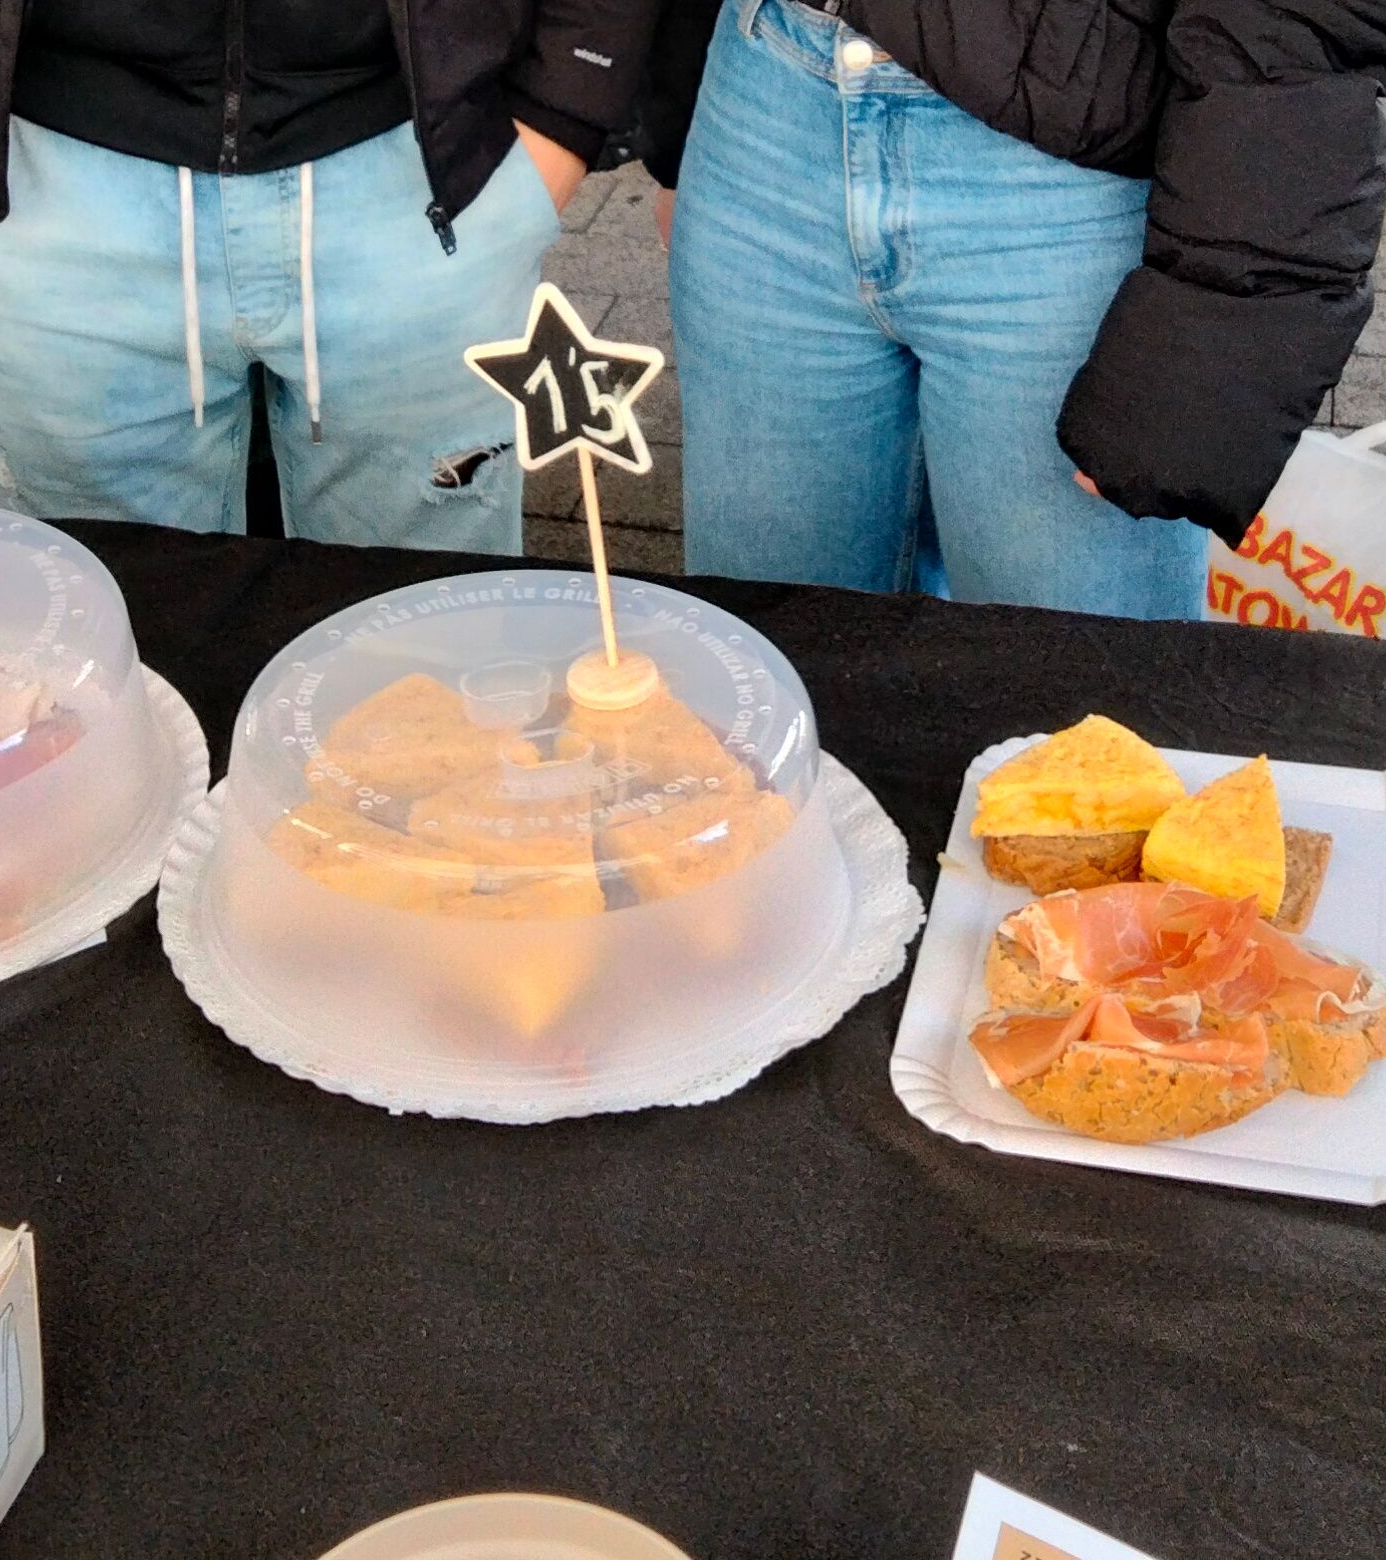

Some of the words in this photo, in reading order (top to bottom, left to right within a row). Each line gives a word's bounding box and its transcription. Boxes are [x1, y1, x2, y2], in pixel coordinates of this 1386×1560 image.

[374, 607, 414, 631] PAS
[415, 587, 504, 615] UTILISER
[512, 587, 537, 600] LE
[294, 670, 326, 708] GRILL
[734, 683, 755, 706] NO
